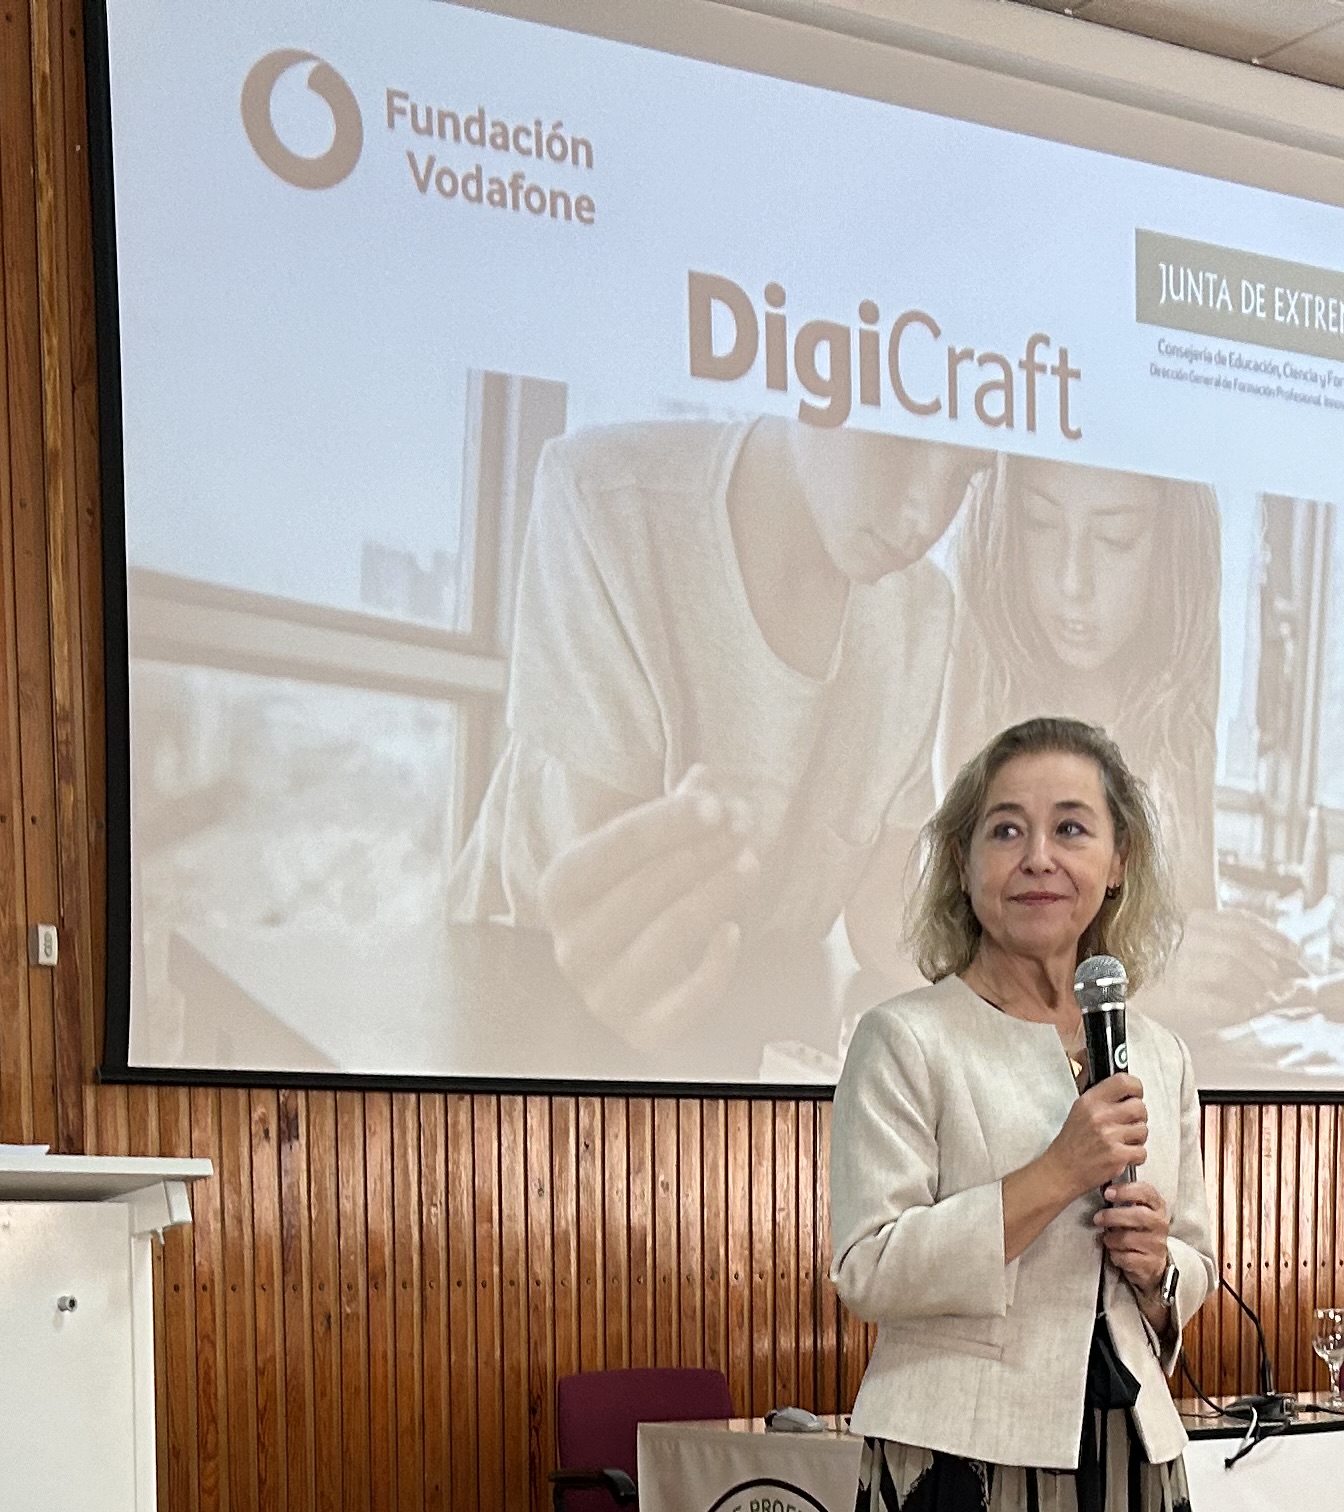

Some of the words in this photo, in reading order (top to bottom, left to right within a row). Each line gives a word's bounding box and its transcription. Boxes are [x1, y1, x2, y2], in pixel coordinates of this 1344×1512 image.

[385, 87, 596, 169] Fundación
[406, 149, 596, 225] Vodafone
[1158, 261, 1233, 313] JUNTA
[1240, 278, 1267, 319] DE
[687, 269, 1084, 440] DigiCraft
[1213, 349, 1227, 366] de
